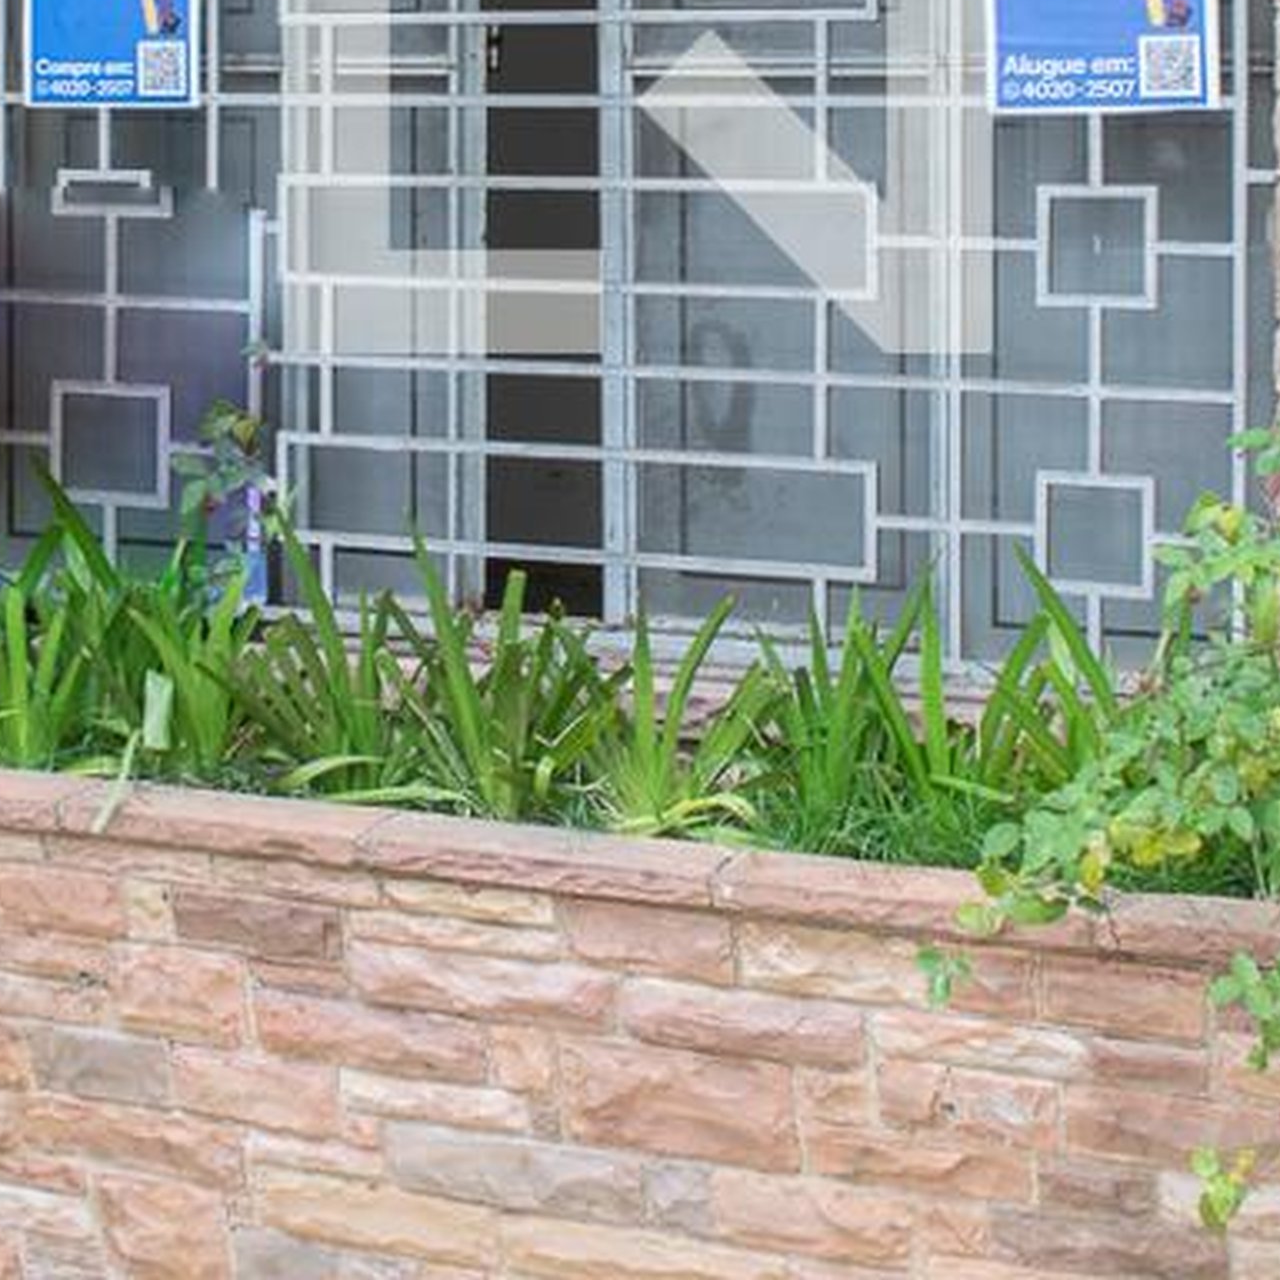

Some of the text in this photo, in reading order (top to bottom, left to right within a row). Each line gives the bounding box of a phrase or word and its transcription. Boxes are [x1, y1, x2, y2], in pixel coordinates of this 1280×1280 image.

[1003, 53, 1136, 80] Alugue em:
[1021, 78, 1137, 100] 4020-2507
